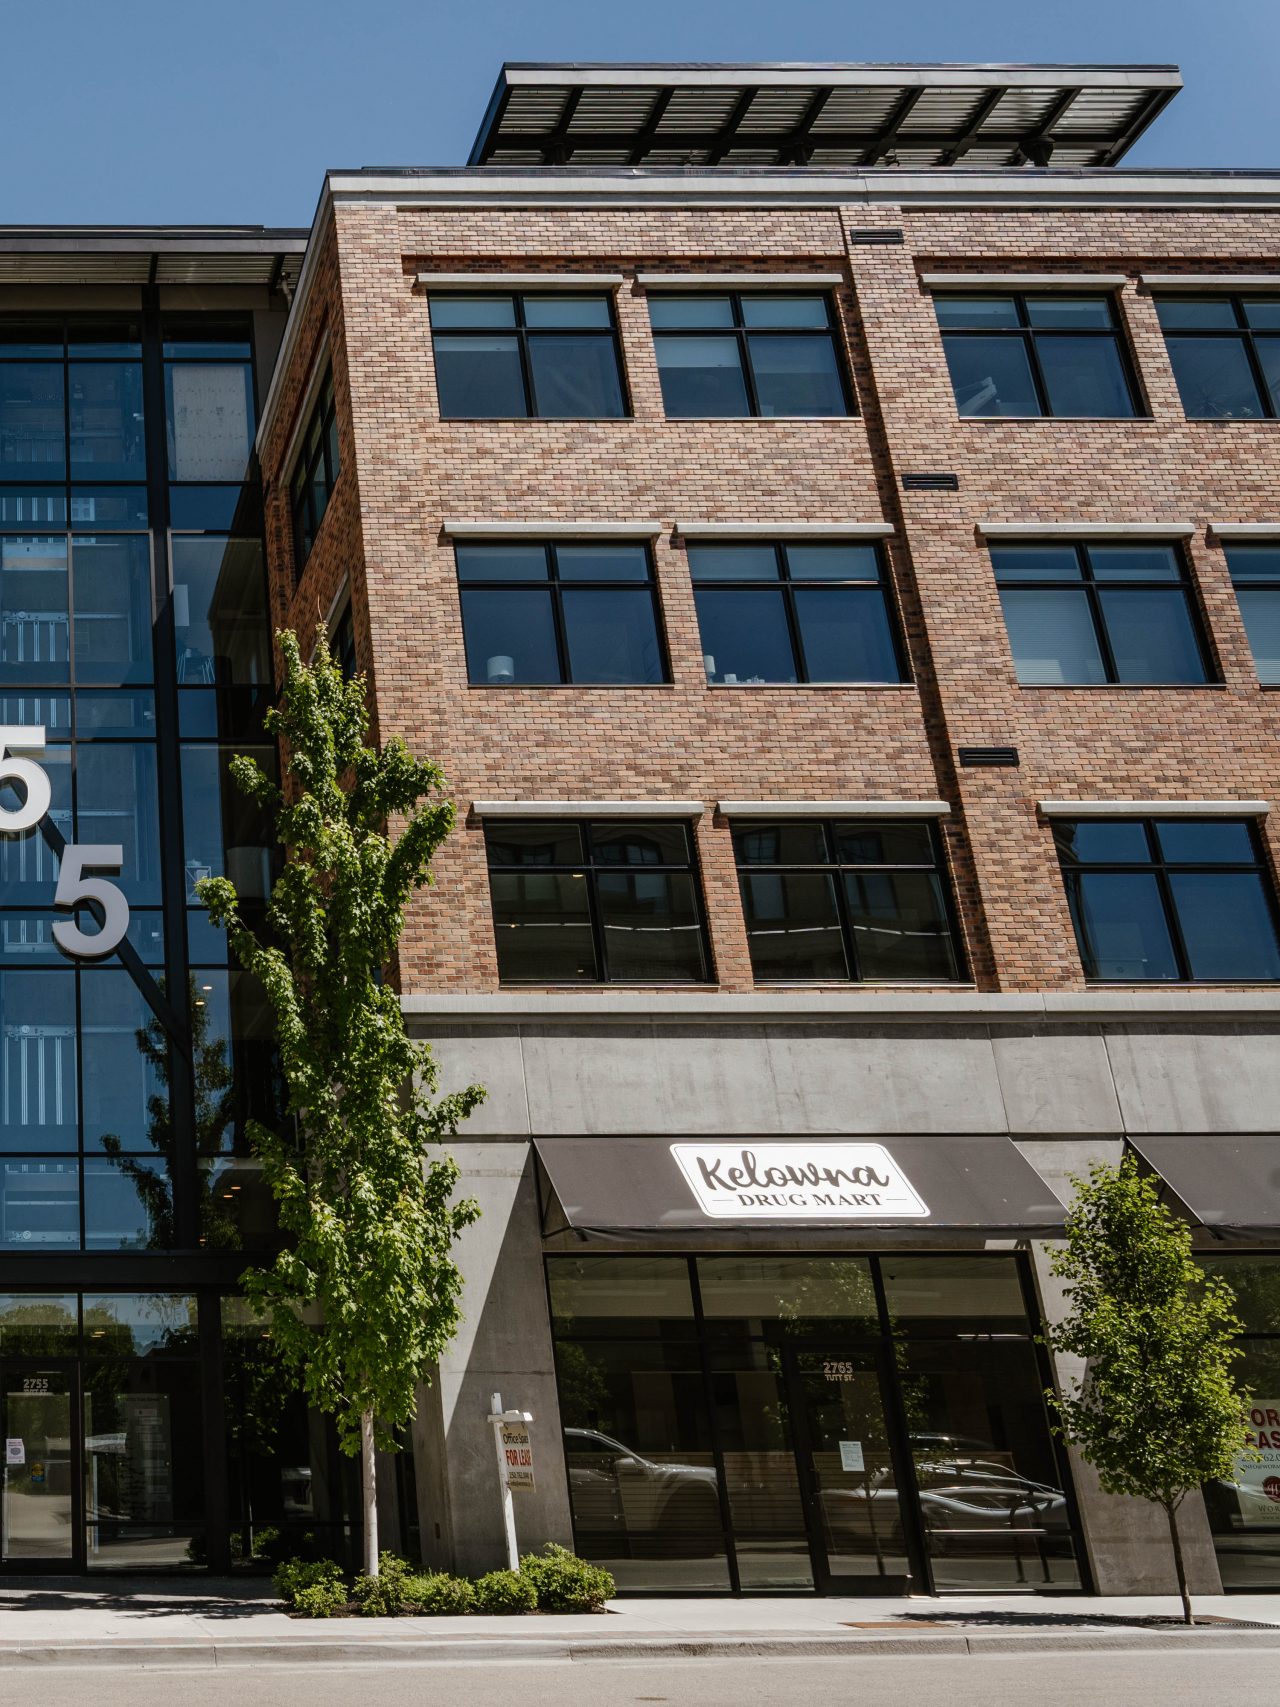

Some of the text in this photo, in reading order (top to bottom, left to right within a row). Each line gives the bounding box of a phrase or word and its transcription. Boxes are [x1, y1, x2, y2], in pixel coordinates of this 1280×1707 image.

[696, 1150, 890, 1191] Kelowna
[737, 1193, 884, 1206] DRUG MART
[823, 1361, 853, 1374] 2765
[23, 1378, 49, 1389] 2755
[1240, 1408, 1280, 1427] OR
[505, 1449, 519, 1467] FOR
